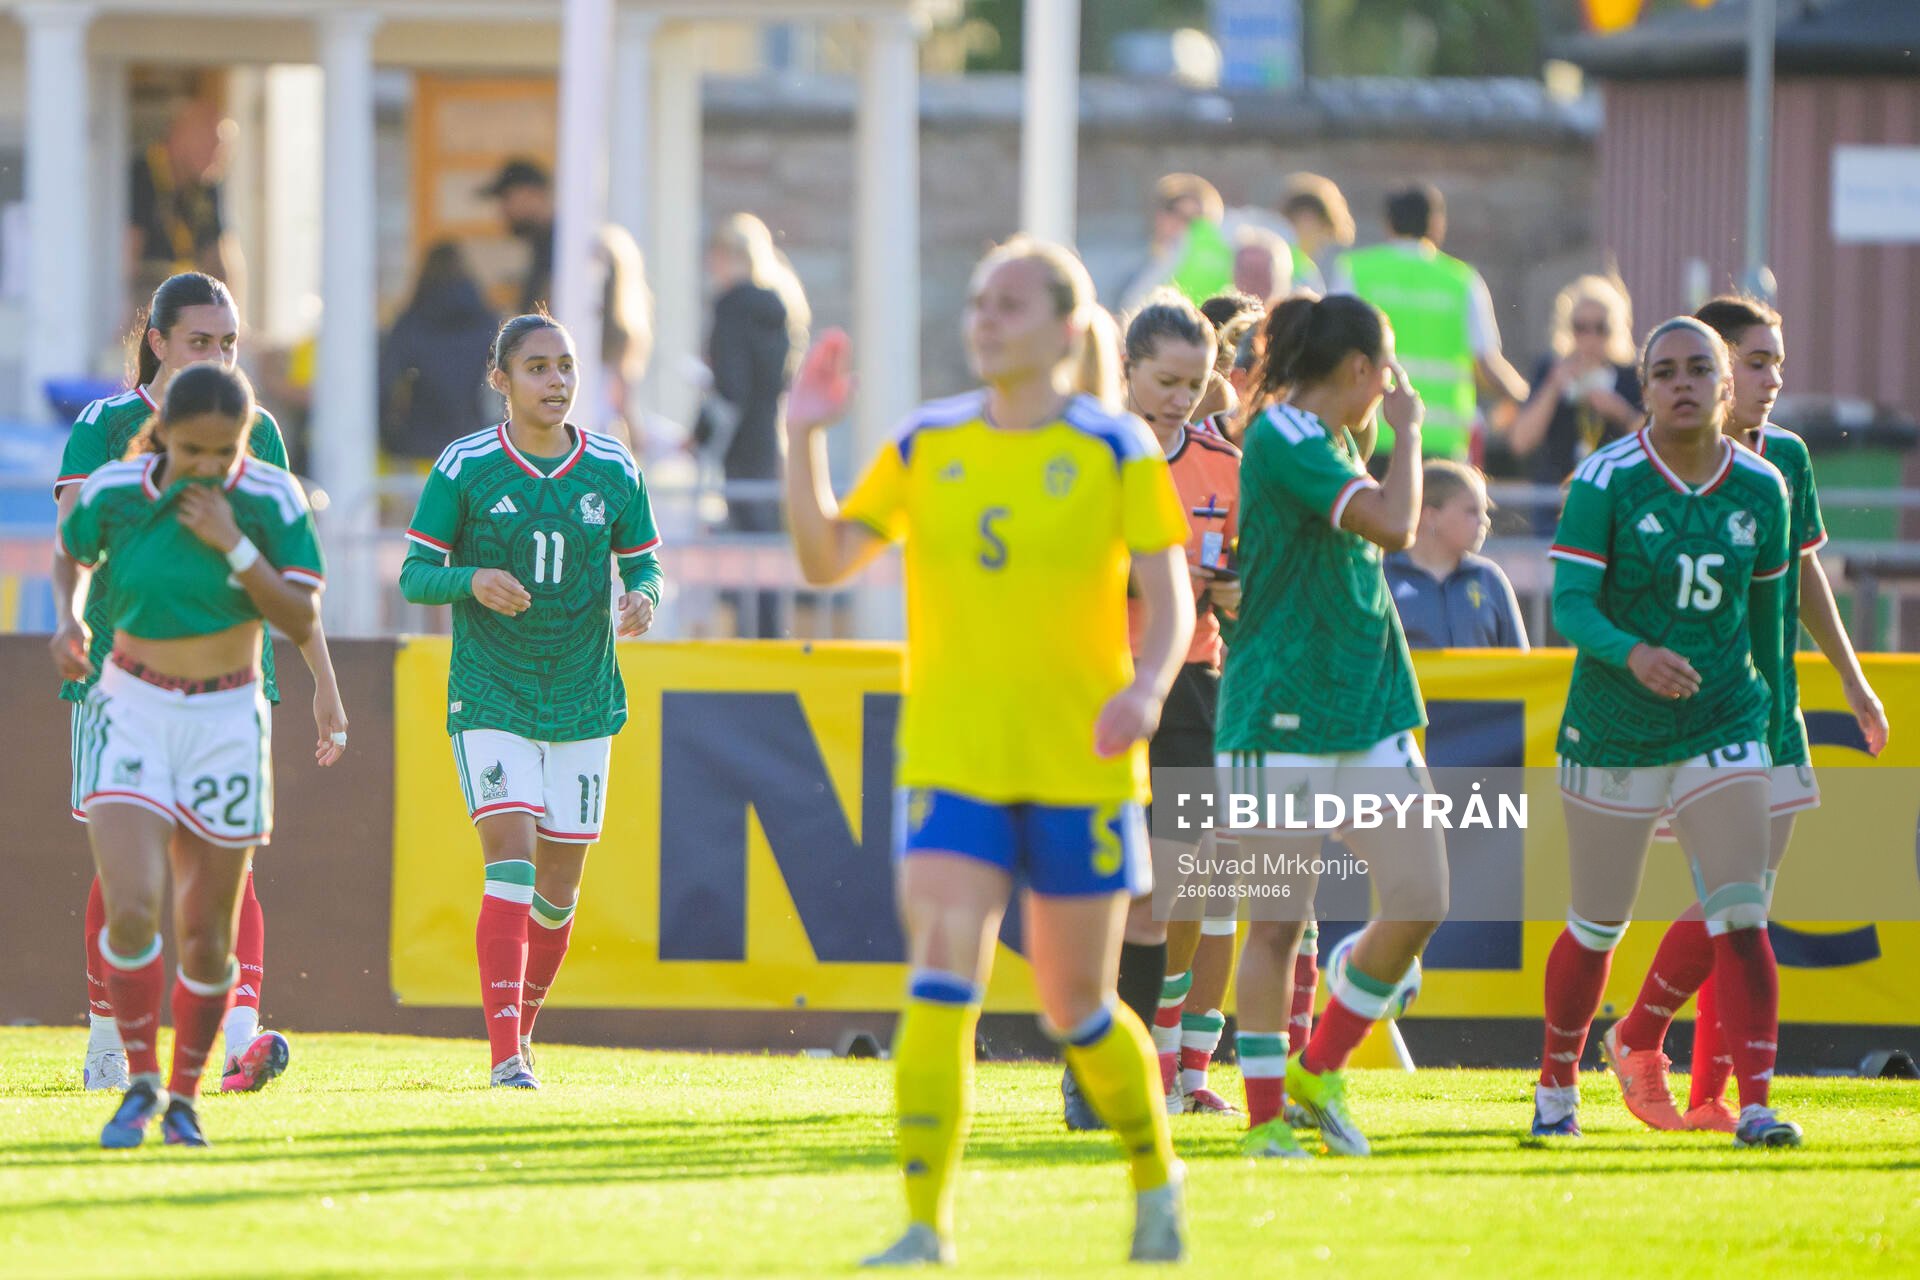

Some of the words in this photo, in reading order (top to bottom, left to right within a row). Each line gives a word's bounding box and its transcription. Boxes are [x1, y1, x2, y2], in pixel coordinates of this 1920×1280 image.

[533, 531, 564, 583] 11
[979, 506, 1010, 570] 5
[1677, 553, 1725, 611] 15
[192, 773, 249, 826] 22
[578, 774, 600, 824] 11
